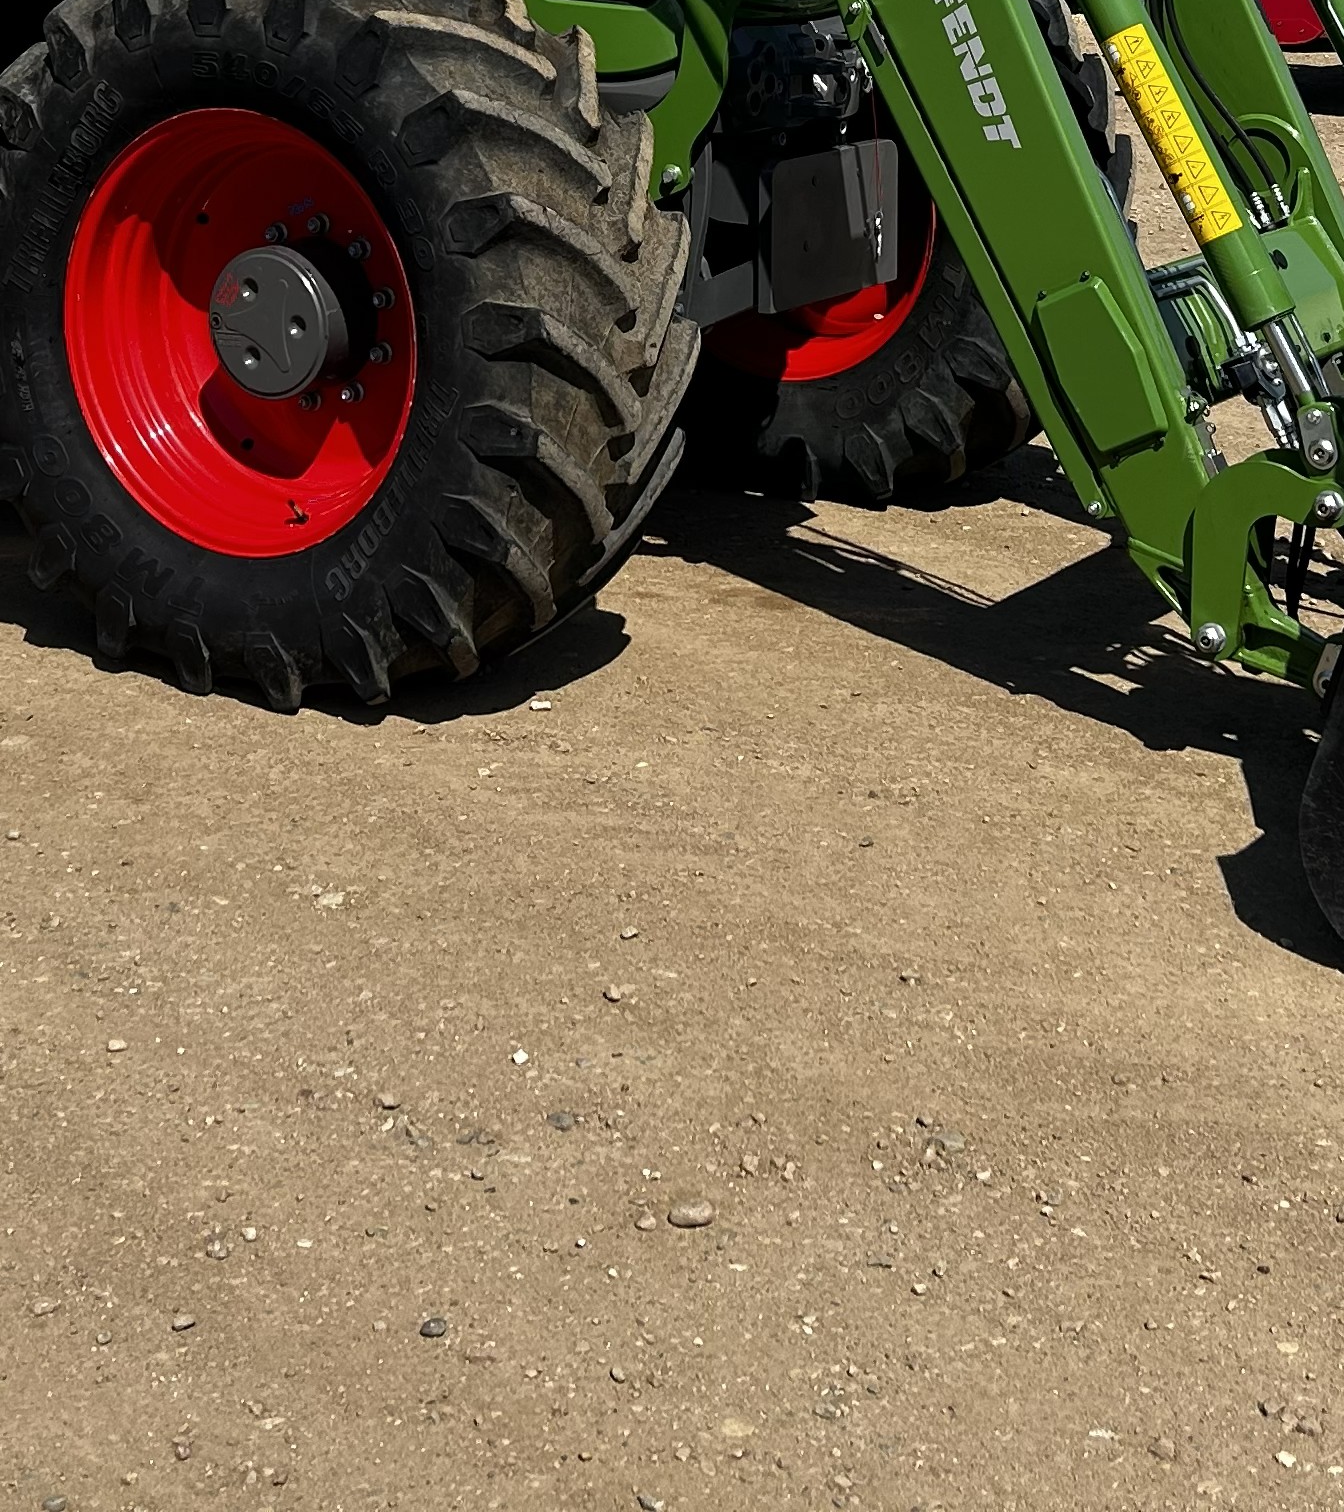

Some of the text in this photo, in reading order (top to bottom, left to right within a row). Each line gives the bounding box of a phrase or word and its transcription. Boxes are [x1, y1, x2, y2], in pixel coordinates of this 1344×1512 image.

[1, 79, 125, 294] TRELLEBORG
[192, 50, 364, 145] 540/65
[32, 433, 205, 617] TM800
[325, 380, 460, 602] TRELLEBORG
